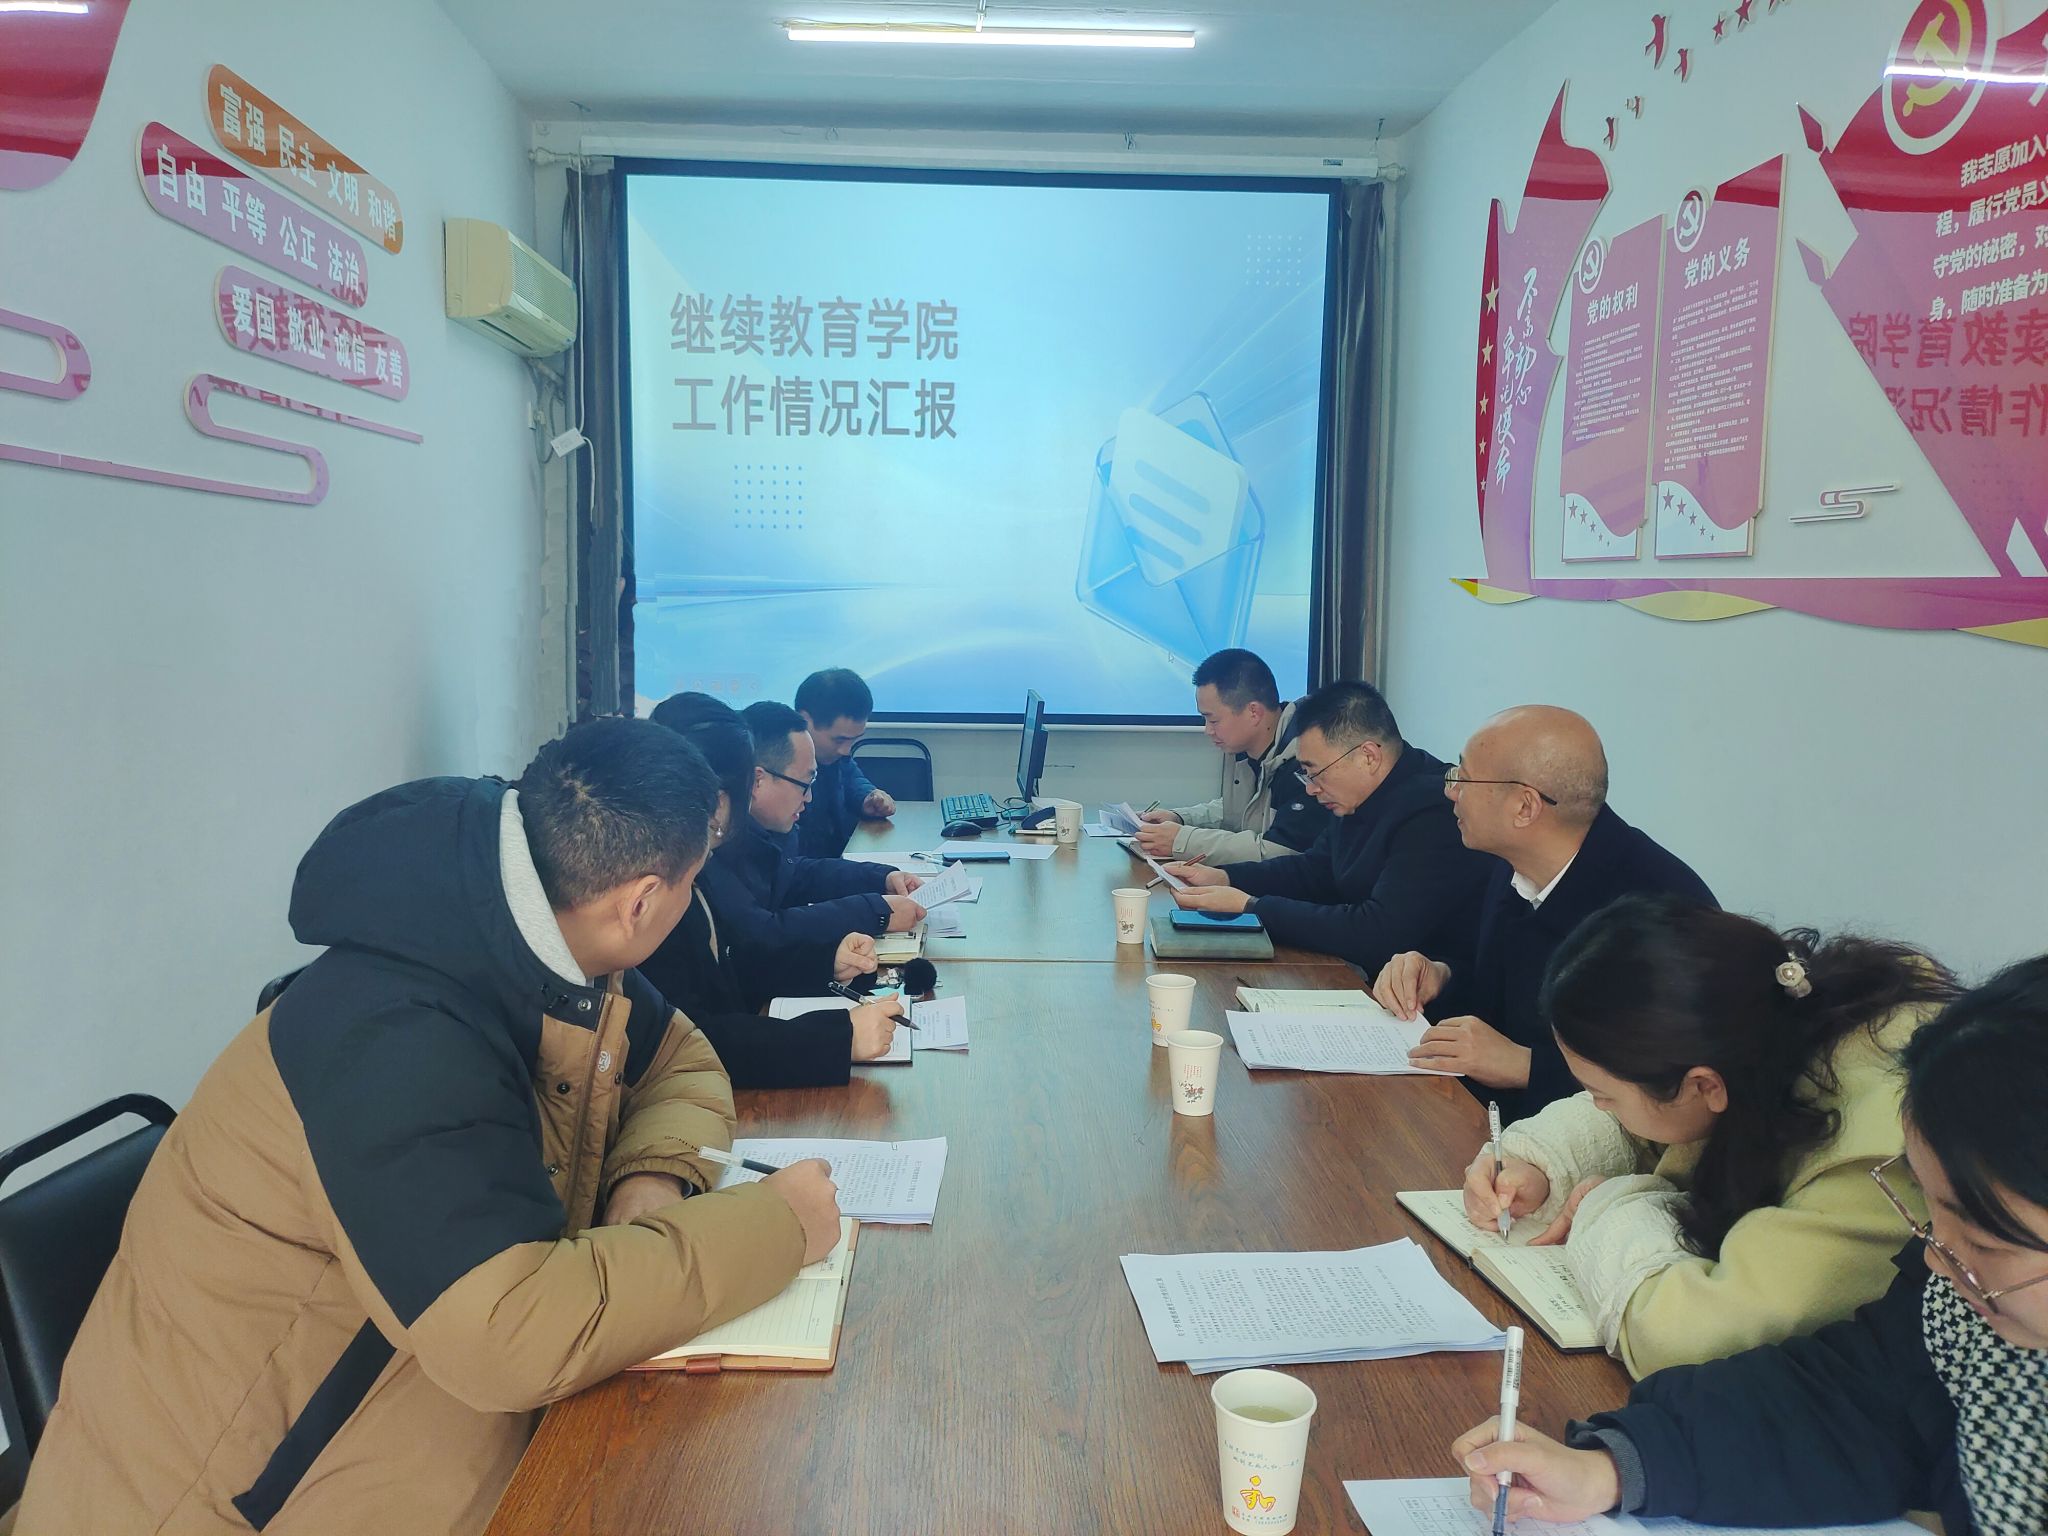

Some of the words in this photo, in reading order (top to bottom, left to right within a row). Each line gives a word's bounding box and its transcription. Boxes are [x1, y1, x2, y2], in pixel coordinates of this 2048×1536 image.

[220, 84, 266, 156] 富强
[279, 124, 317, 188] 民主
[327, 161, 359, 216] 文明
[368, 189, 398, 241] 和谐
[1960, 133, 2048, 188] 我志愿加入
[157, 144, 207, 216] 自由
[222, 179, 267, 246] 平等
[280, 216, 318, 271] 公正
[328, 240, 360, 292] 法治
[1684, 237, 1750, 290] 党的义务
[232, 284, 276, 344] 爱国
[287, 306, 326, 360] 敬业
[334, 327, 366, 376] 诚信
[375, 344, 403, 389] 友善
[670, 292, 958, 361] 继续教育学院
[1586, 282, 1638, 326] 党的权利
[672, 374, 957, 440] 工作情况汇报
